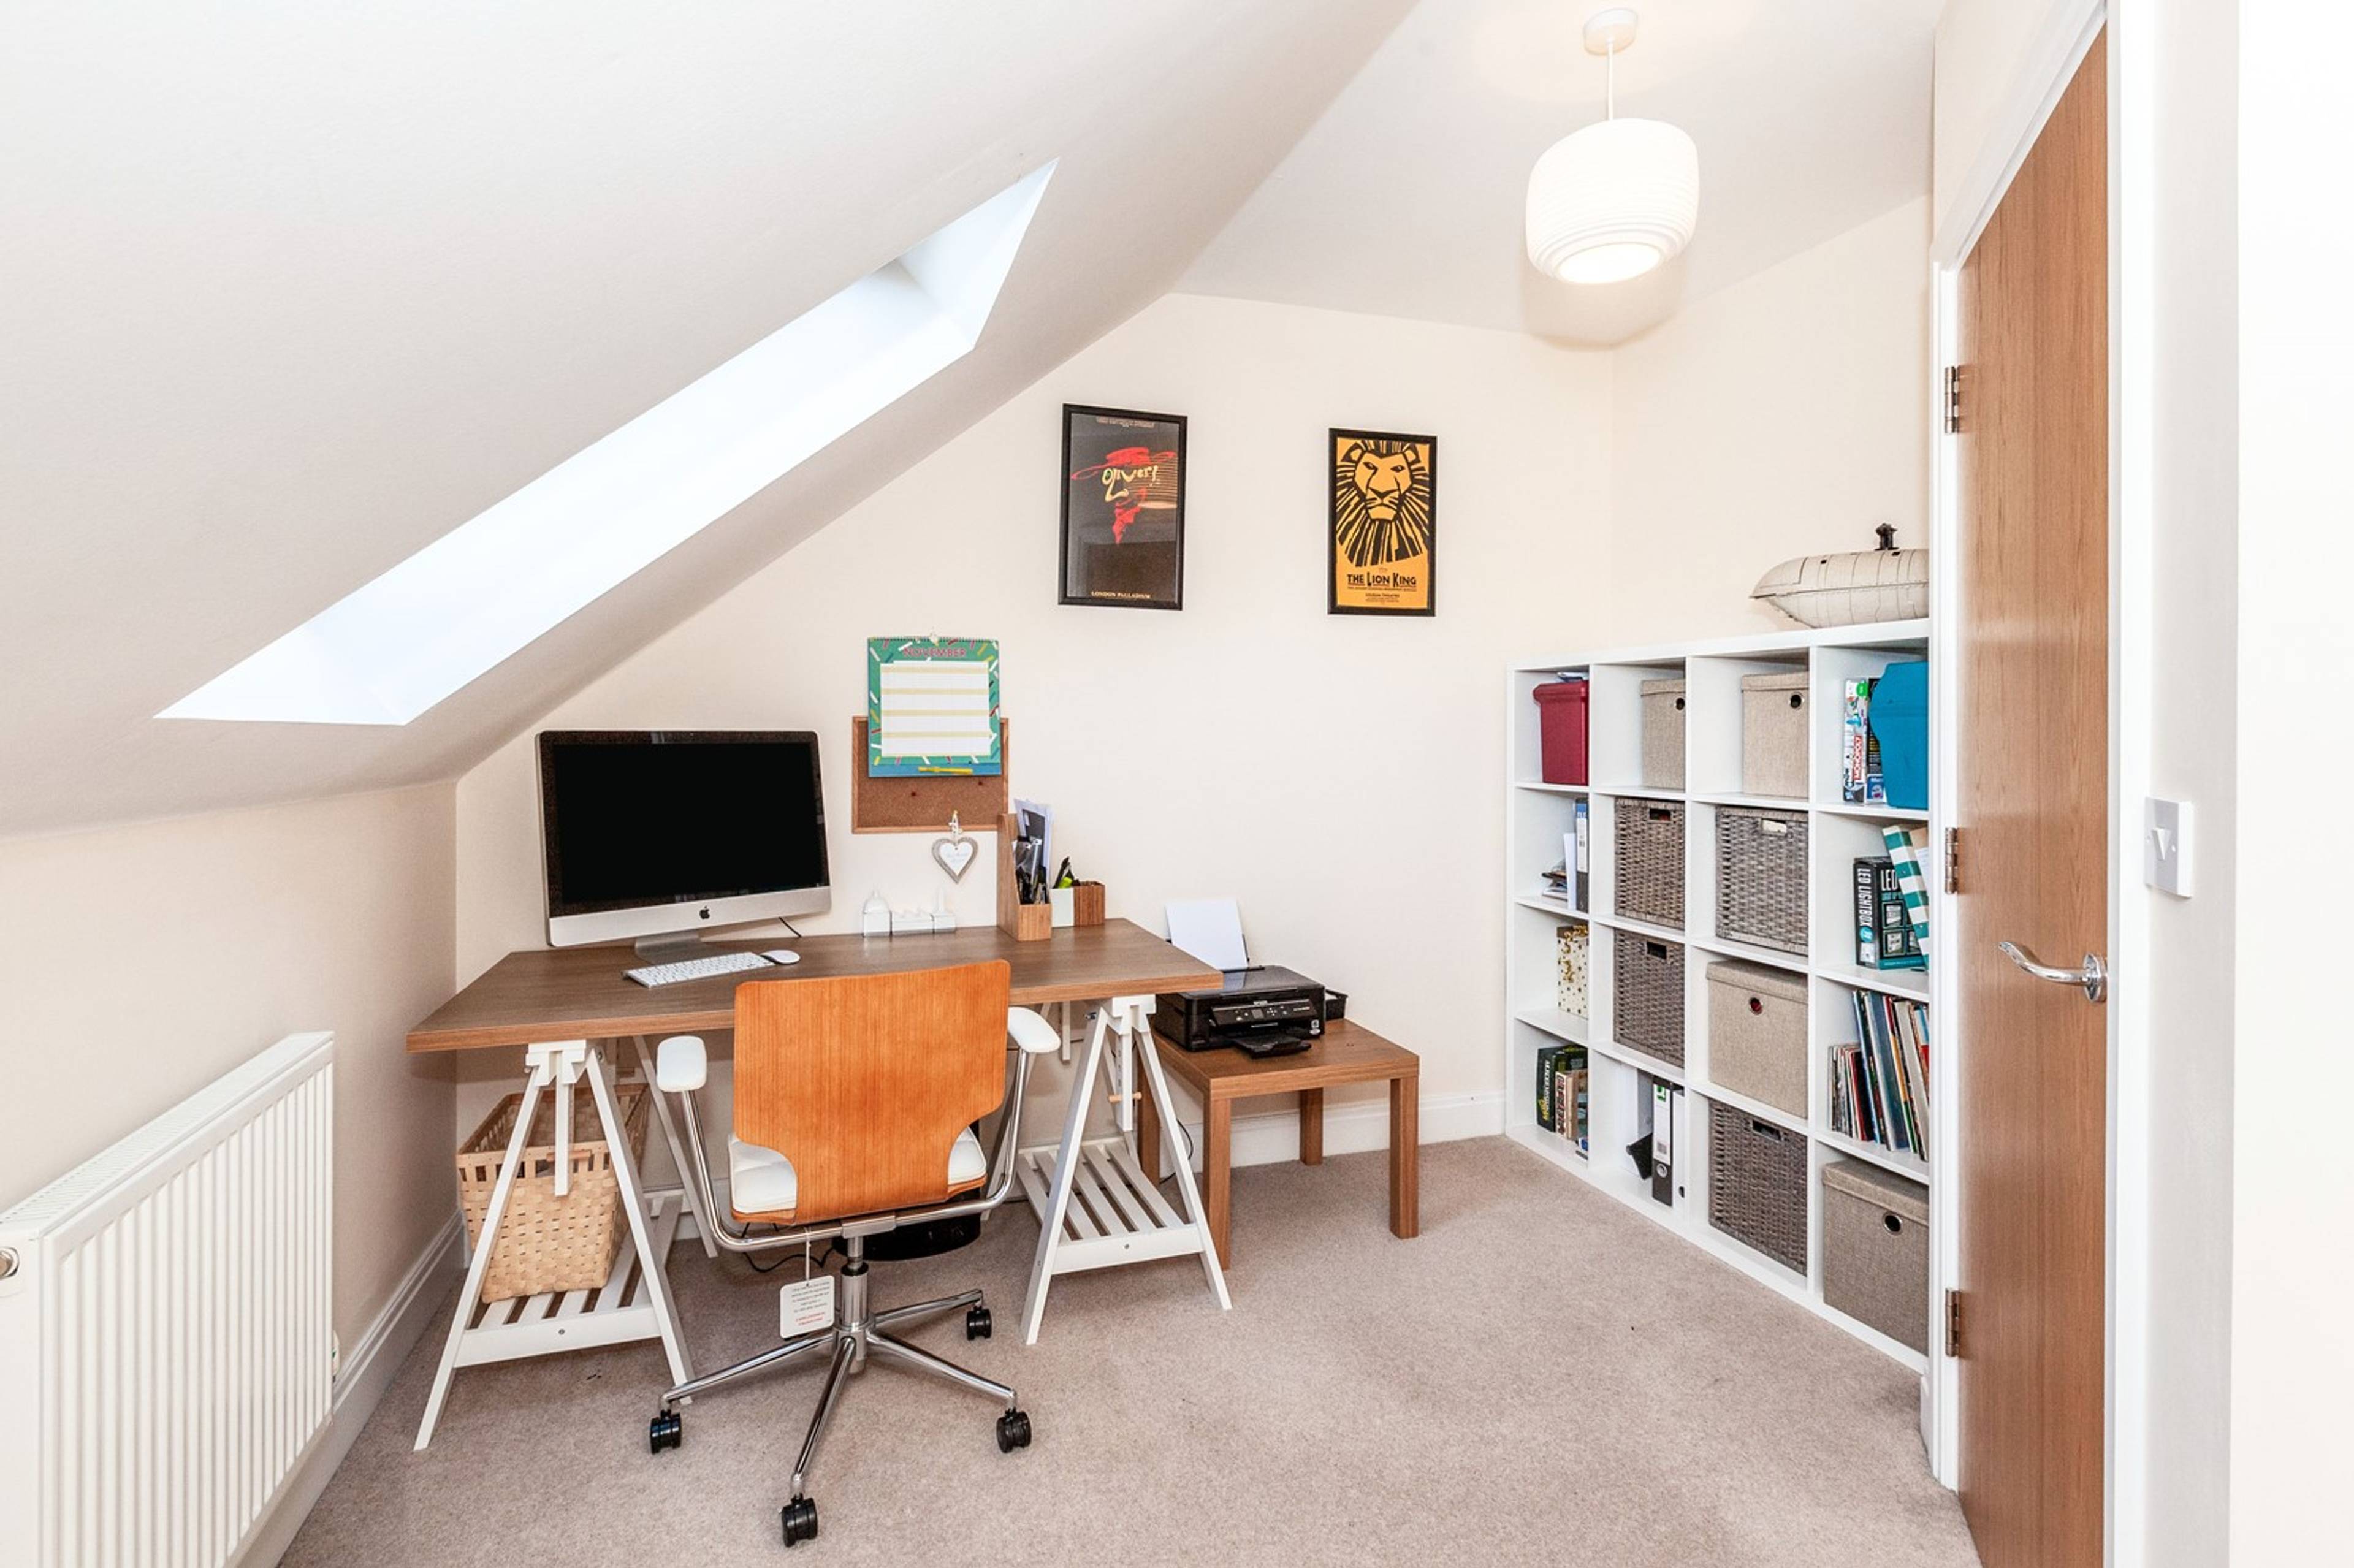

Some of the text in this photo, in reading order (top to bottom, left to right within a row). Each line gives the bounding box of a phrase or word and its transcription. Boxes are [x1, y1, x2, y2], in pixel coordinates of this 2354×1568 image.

[1347, 571, 1416, 588] THE LION KING
[903, 647, 966, 657] NOVEMBER
[1857, 868, 1873, 927] LED LIGHTBOX
